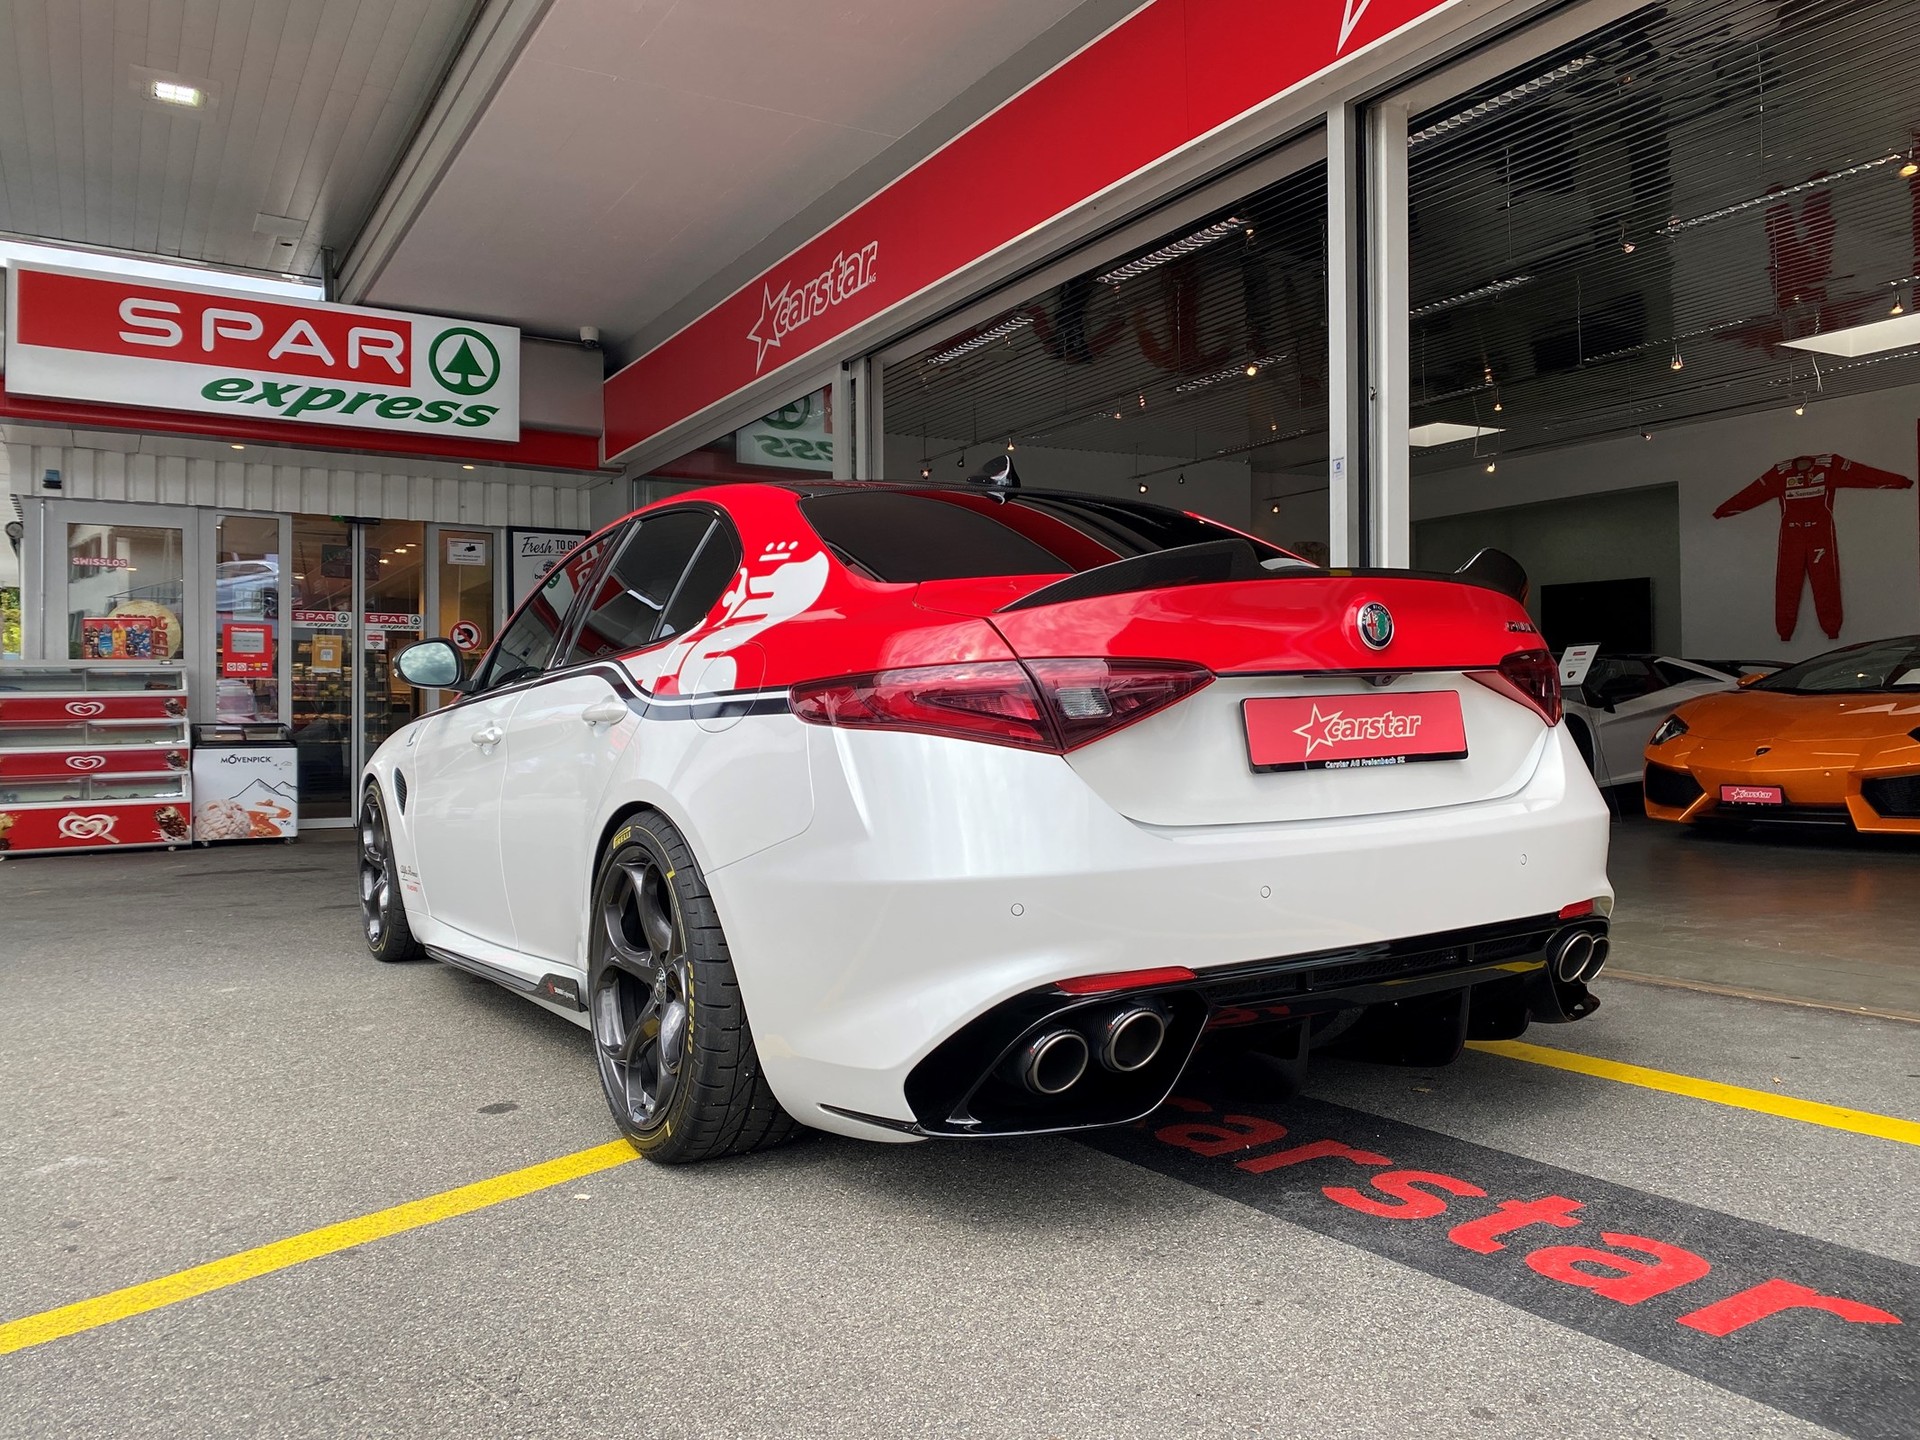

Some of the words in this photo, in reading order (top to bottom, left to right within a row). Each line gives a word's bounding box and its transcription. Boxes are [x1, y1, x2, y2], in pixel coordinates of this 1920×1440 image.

[774, 240, 878, 338] carstar
[118, 297, 405, 374] SPAR
[200, 377, 500, 427] express
[521, 536, 553, 554] Fresh
[555, 540, 566, 550] TO
[567, 541, 578, 551] GO
[73, 557, 127, 567] SWISSLOS
[1813, 548, 1825, 563] 7
[295, 612, 335, 621] SPAR
[369, 615, 408, 623] SPAR
[306, 621, 349, 629] express
[1324, 710, 1422, 742] carstar
